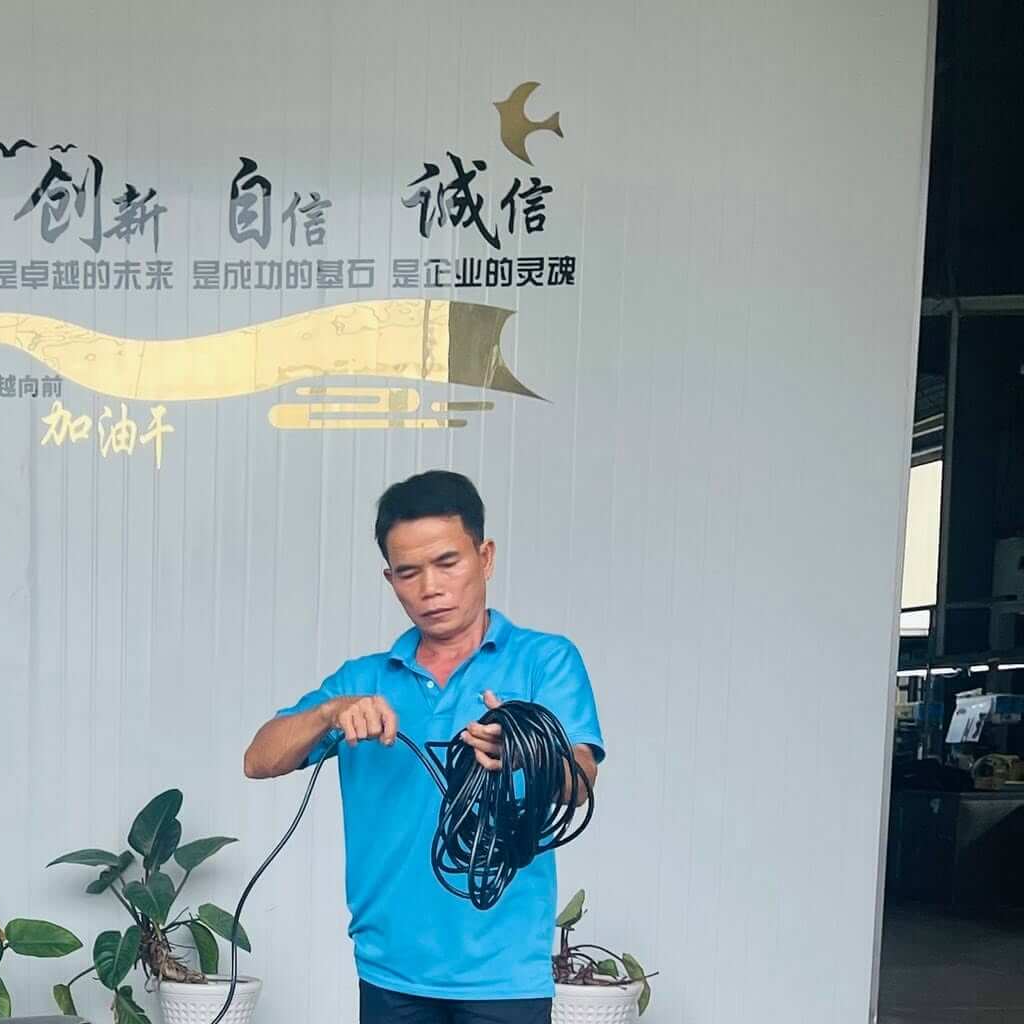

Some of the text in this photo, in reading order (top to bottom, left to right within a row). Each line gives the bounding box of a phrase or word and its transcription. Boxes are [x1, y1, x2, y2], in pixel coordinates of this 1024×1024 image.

[13, 154, 168, 253] 创新
[229, 156, 332, 249] 自信
[401, 151, 553, 250] 诚信
[192, 258, 376, 291] 是成功的基石
[392, 255, 576, 289] 是企业的灵魂
